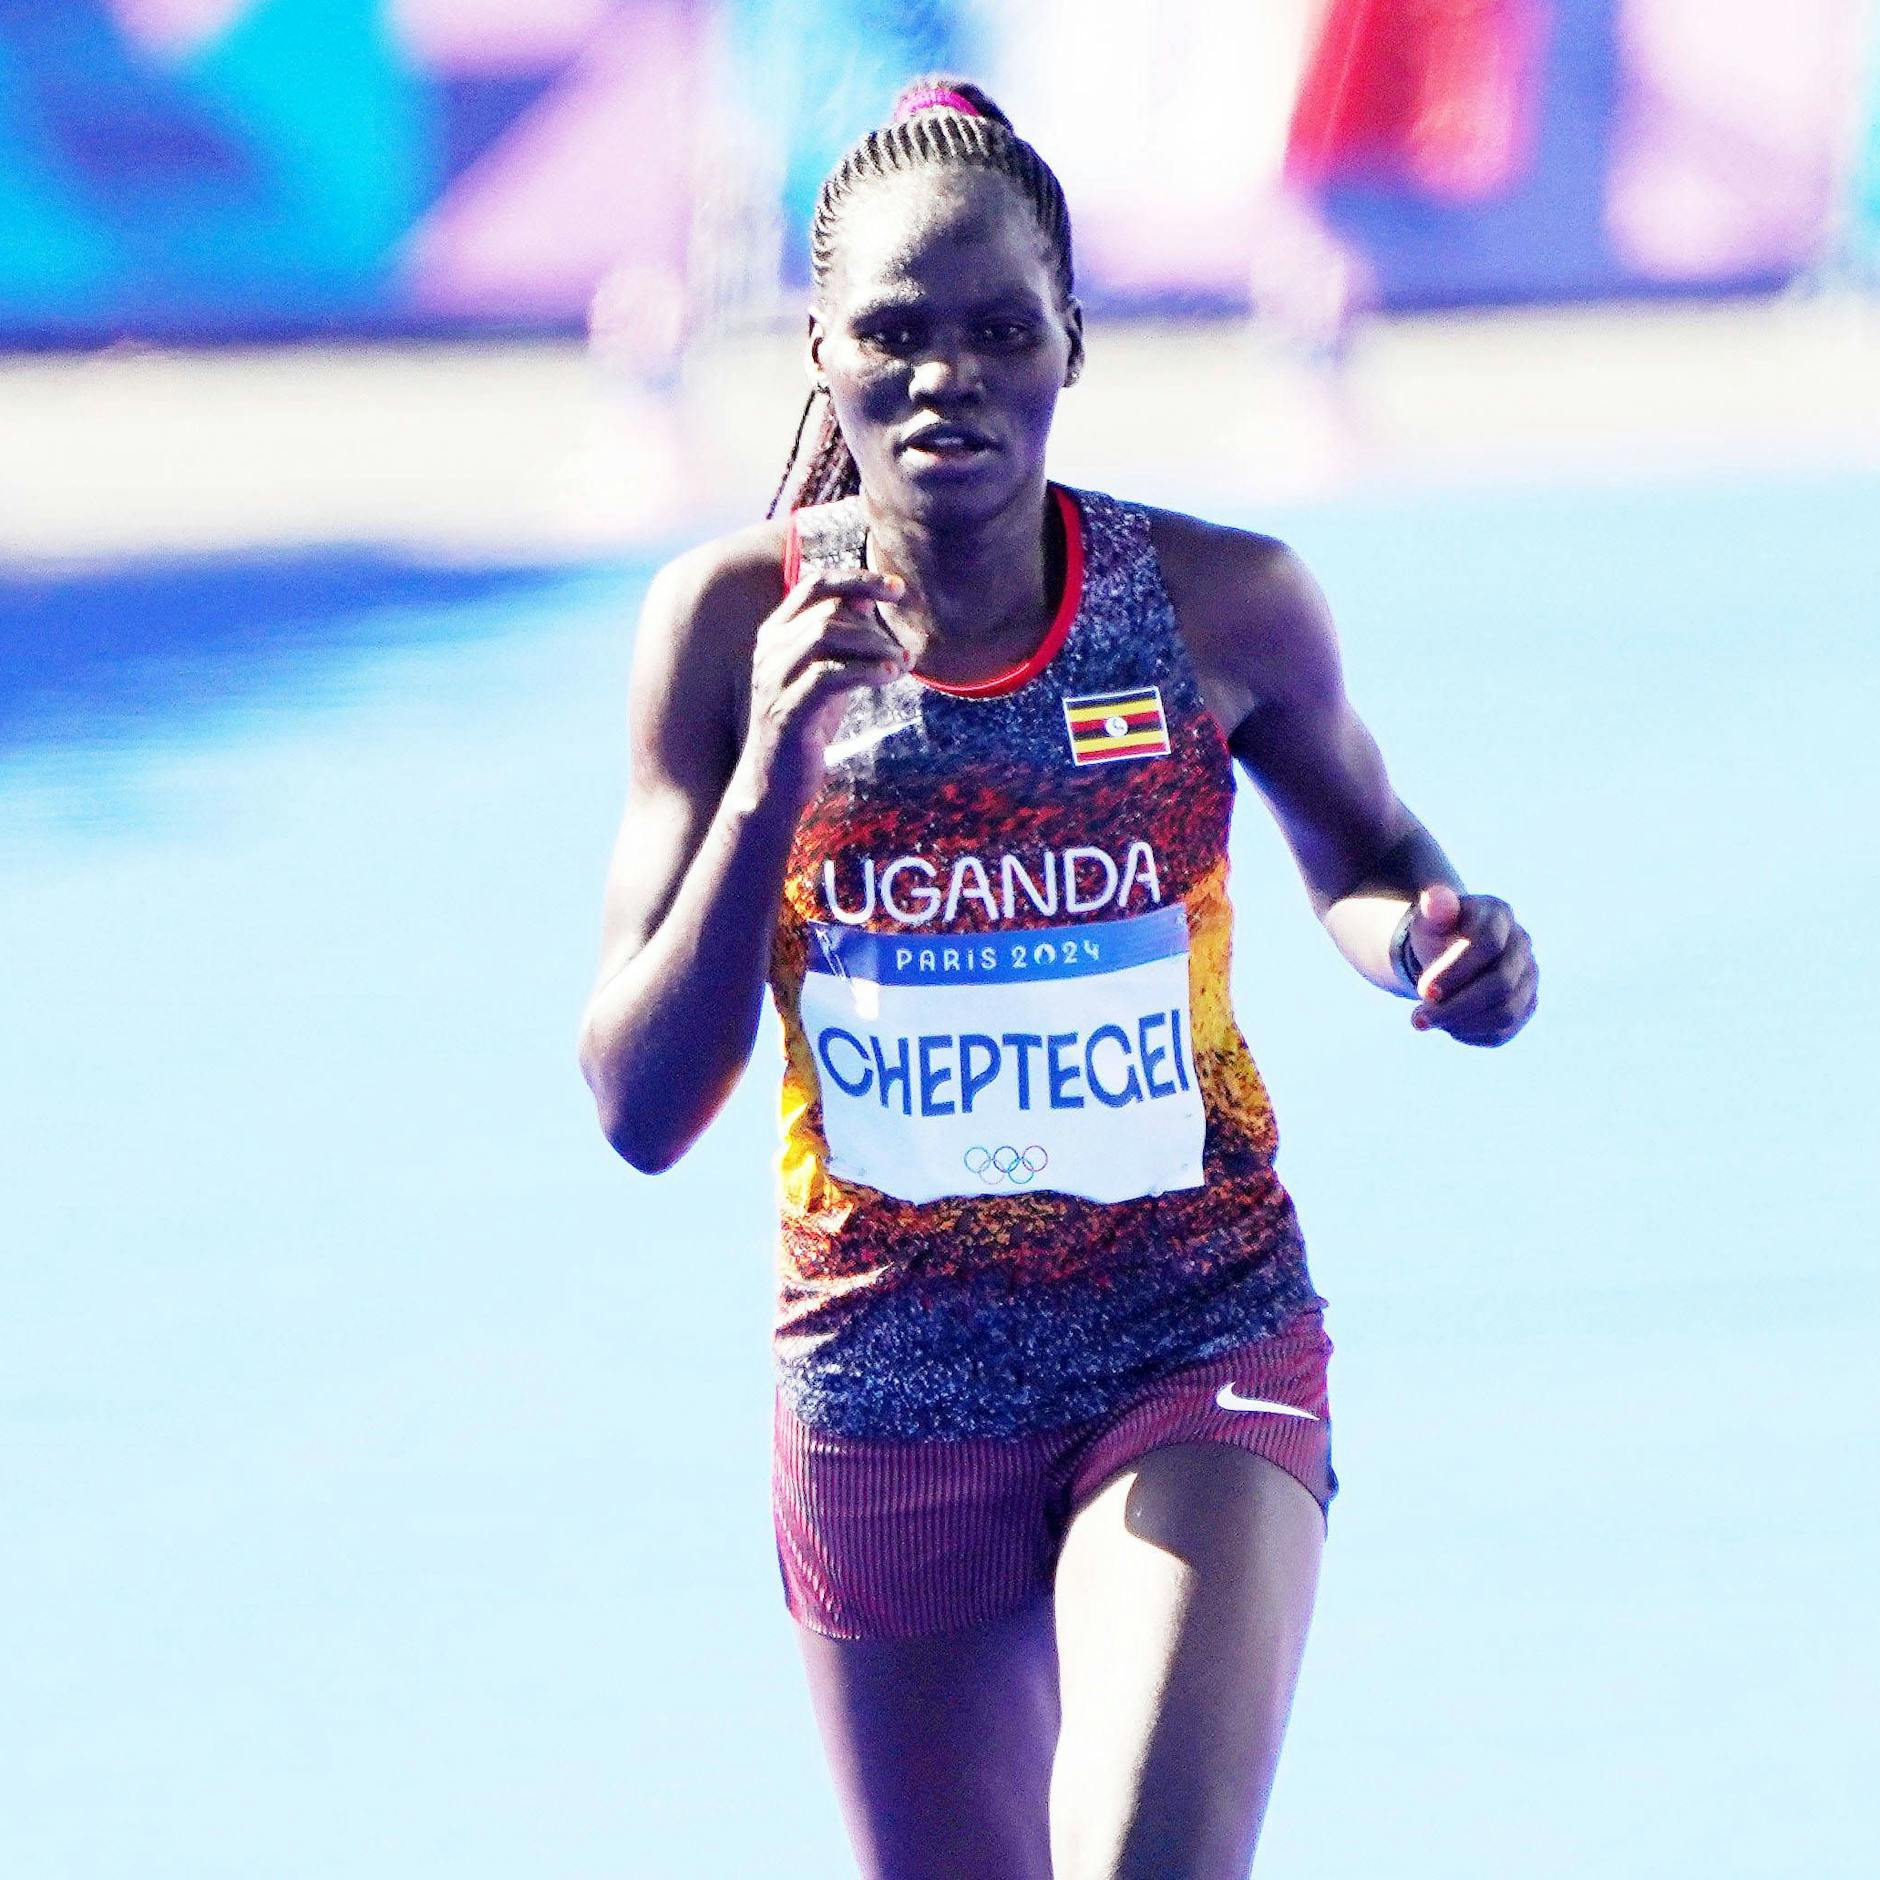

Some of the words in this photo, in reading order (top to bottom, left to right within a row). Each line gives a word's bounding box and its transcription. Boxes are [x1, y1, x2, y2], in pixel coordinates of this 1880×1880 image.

[823, 842, 1161, 924] UGANDA
[1011, 940, 1100, 969] 2024
[818, 1009, 1190, 1117] CHEPTEGEI
